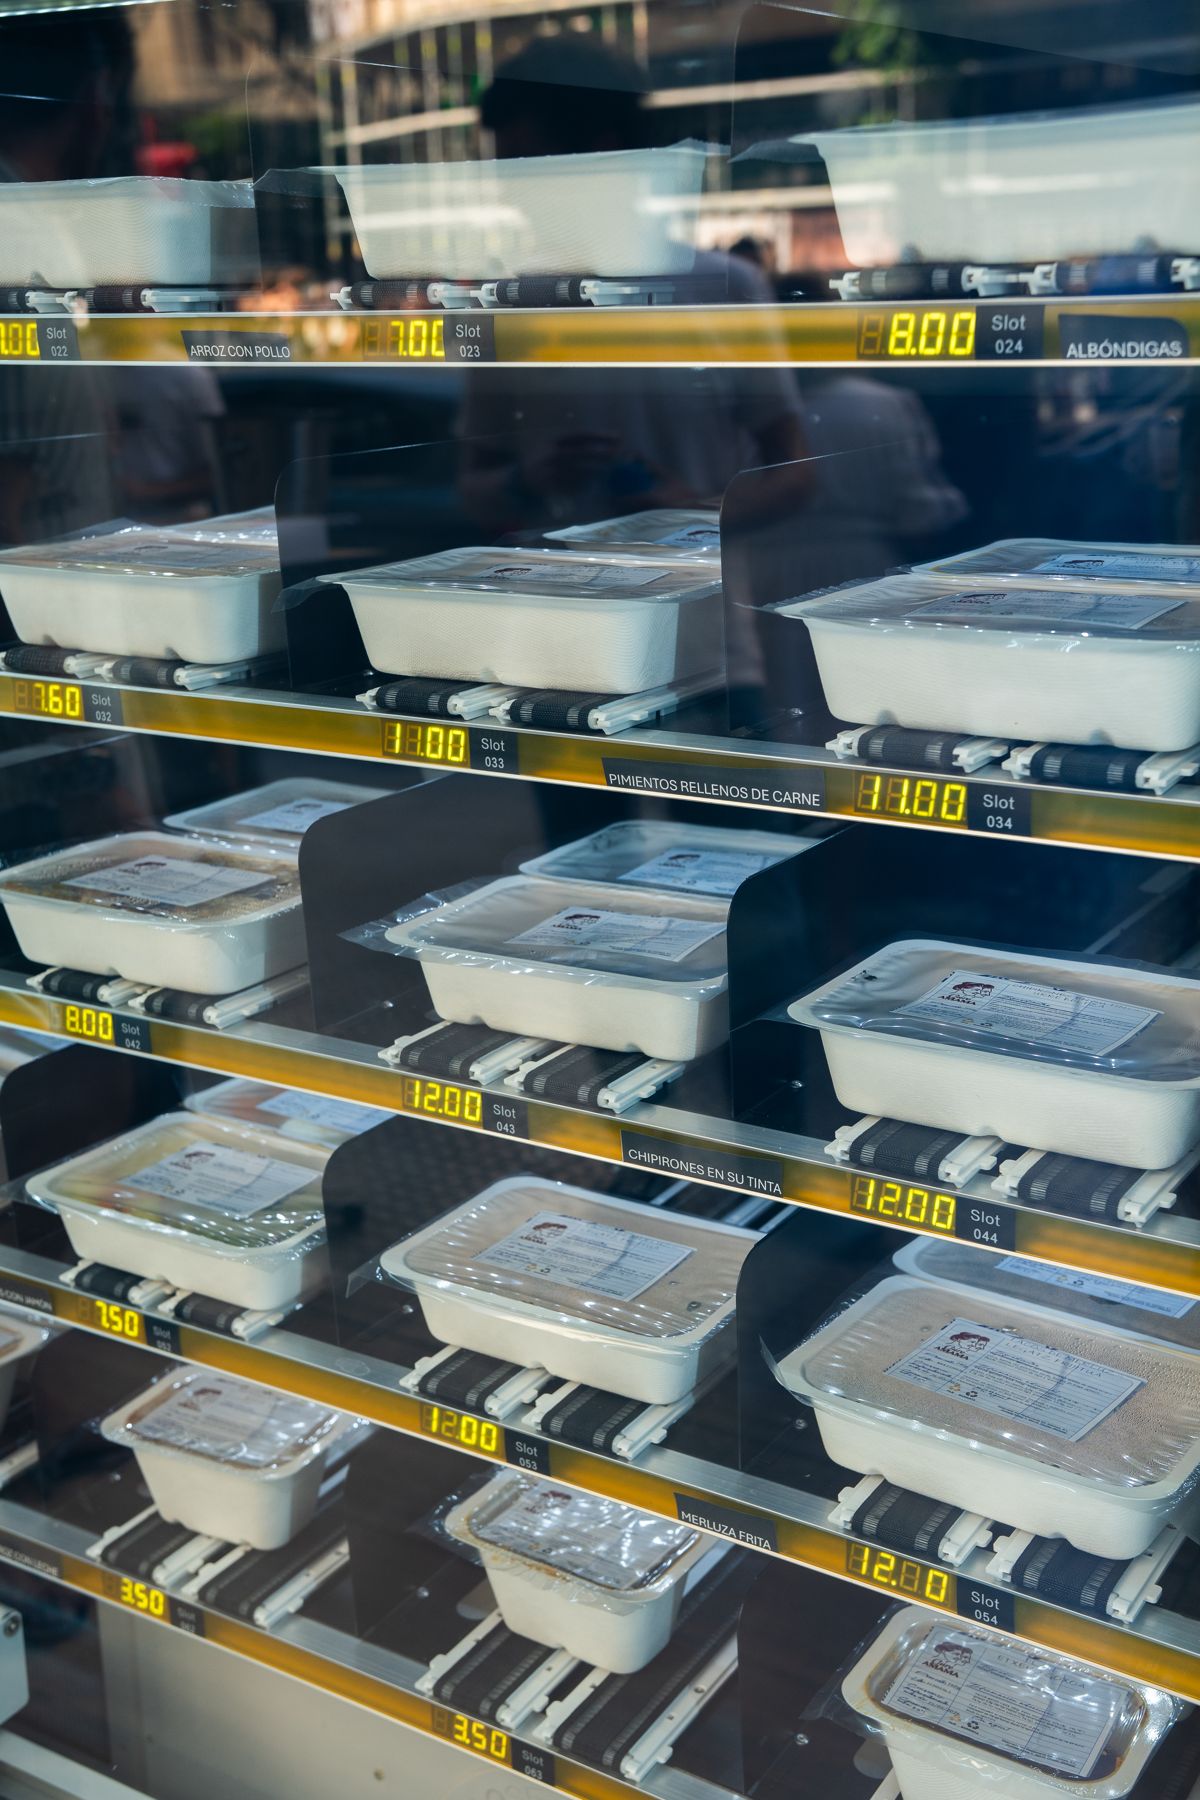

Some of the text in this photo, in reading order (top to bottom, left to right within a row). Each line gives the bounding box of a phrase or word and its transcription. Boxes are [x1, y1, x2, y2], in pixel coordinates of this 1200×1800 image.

[992, 314, 1026, 331] Slot
[46, 327, 67, 340] Slot
[455, 324, 481, 338] Slot
[888, 312, 976, 356] 8.00
[51, 346, 68, 357] 022
[190, 345, 291, 358] ARROZ CON POLLO
[459, 345, 481, 358] 023
[995, 339, 1024, 354] 024
[1066, 339, 1183, 359] ALBÓNDIGAS
[91, 694, 112, 707] Slot
[95, 710, 112, 722] 032
[481, 738, 505, 752] Slot
[484, 756, 505, 769] 033
[608, 773, 820, 807] PIMIENTOS RELLENOS DE CARNE
[871, 775, 967, 821] 11.00
[983, 794, 1015, 810] Slot
[986, 816, 1013, 830] 034
[66, 1005, 112, 1040] 8.00
[121, 1023, 140, 1036] Slot
[125, 1039, 141, 1050] 042
[413, 1080, 482, 1122] 12.00
[493, 1104, 516, 1119] Slot
[496, 1121, 516, 1134] 043
[628, 1149, 782, 1195] CHIPIRONES EN SU TINTA
[865, 1179, 956, 1230] 12.00
[970, 1209, 1001, 1227] Slot
[973, 1228, 998, 1244] 044
[153, 1326, 171, 1340] Slot
[431, 1406, 497, 1452] 12.00
[515, 1441, 538, 1457] Slot
[519, 1457, 538, 1471] 053
[681, 1511, 772, 1551] MERLUZA FRITA
[971, 1591, 1000, 1611] Slot
[974, 1609, 998, 1625] 054
[454, 1714, 507, 1759] 3.50
[522, 1750, 544, 1766] Slot
[524, 1765, 543, 1780] 063
